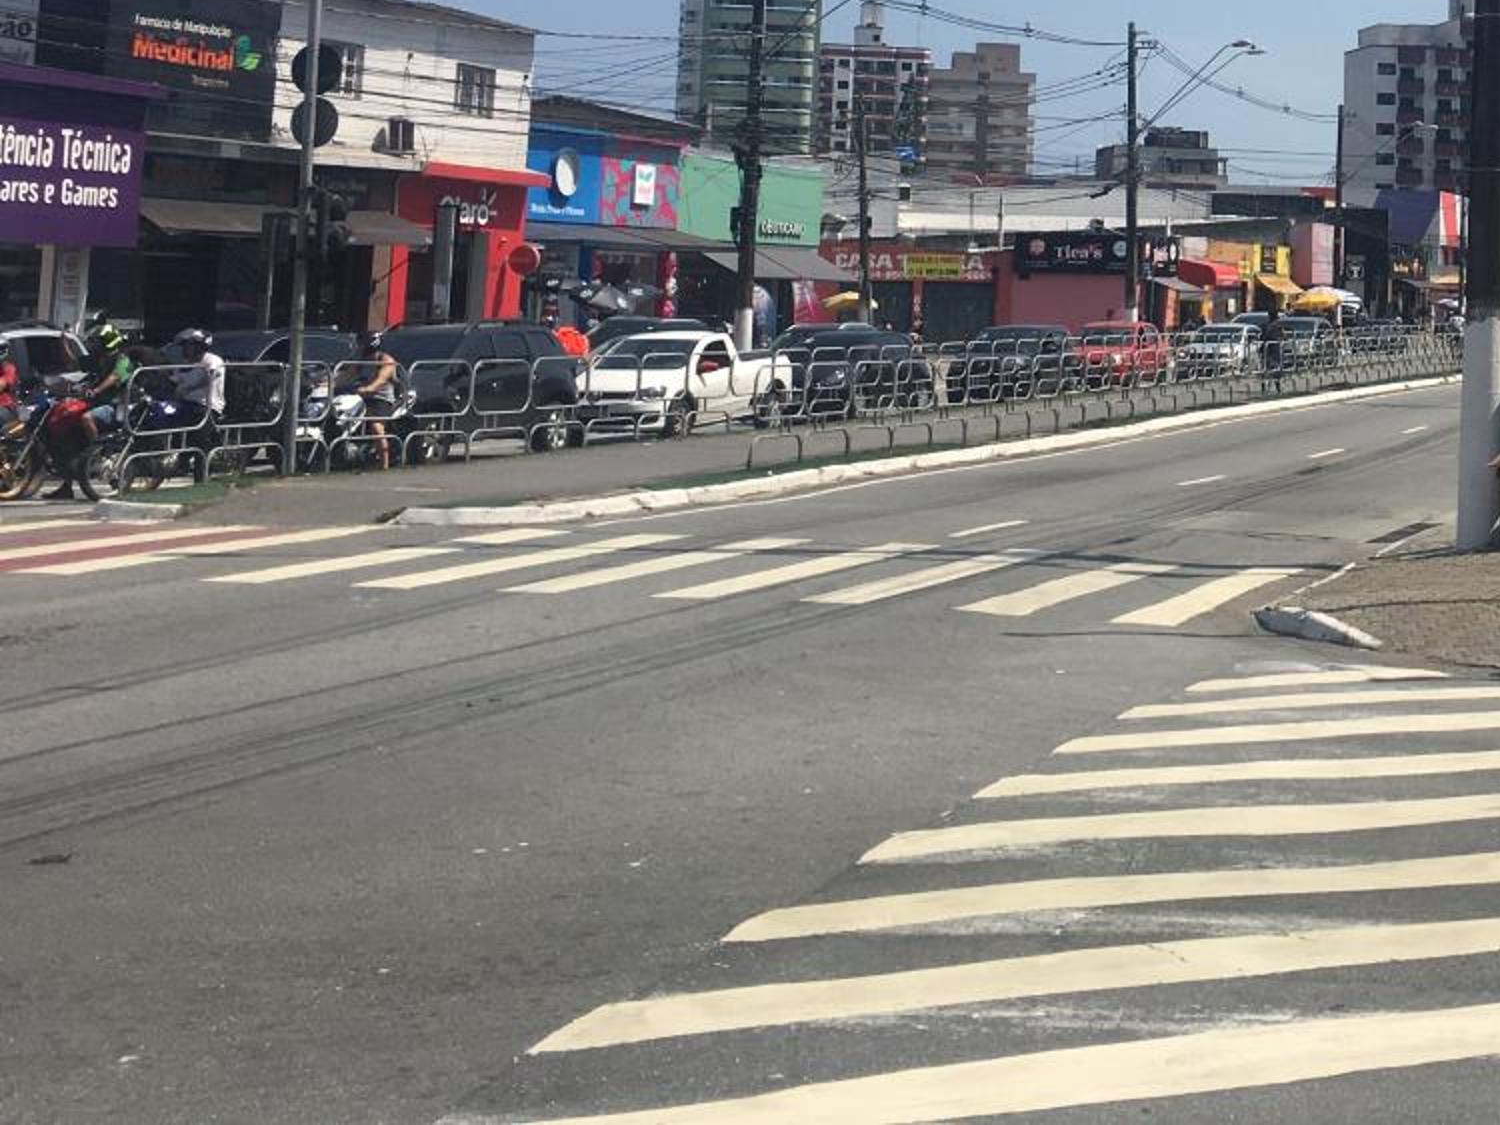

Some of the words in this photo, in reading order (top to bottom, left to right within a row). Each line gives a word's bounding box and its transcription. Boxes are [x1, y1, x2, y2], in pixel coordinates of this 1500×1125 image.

[0, 11, 33, 38] ão
[132, 34, 235, 71] Medicinal
[61, 128, 132, 174] Técnica
[44, 183, 55, 204] e
[61, 178, 119, 208] Games
